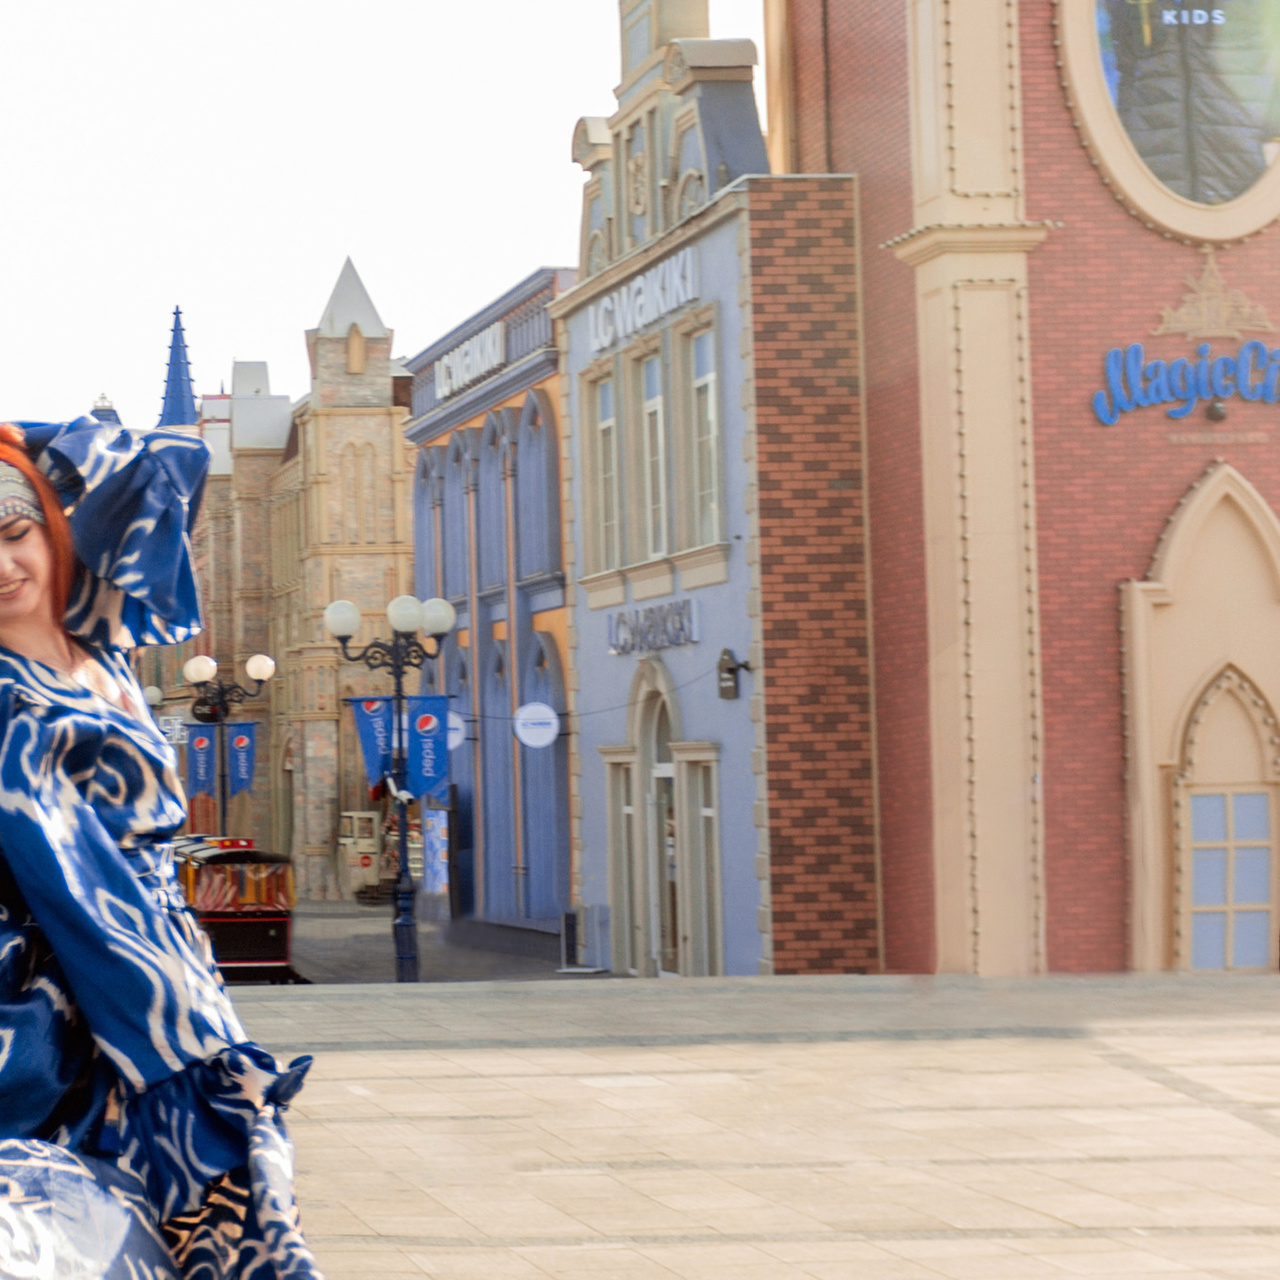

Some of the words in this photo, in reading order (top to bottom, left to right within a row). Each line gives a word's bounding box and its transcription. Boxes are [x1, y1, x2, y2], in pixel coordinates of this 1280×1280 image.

[1161, 9, 1226, 26] KIDS
[373, 717, 390, 755] pepsi
[196, 753, 207, 780] pepsi
[237, 752, 249, 779] pepsi
[421, 738, 437, 777] pepsi
